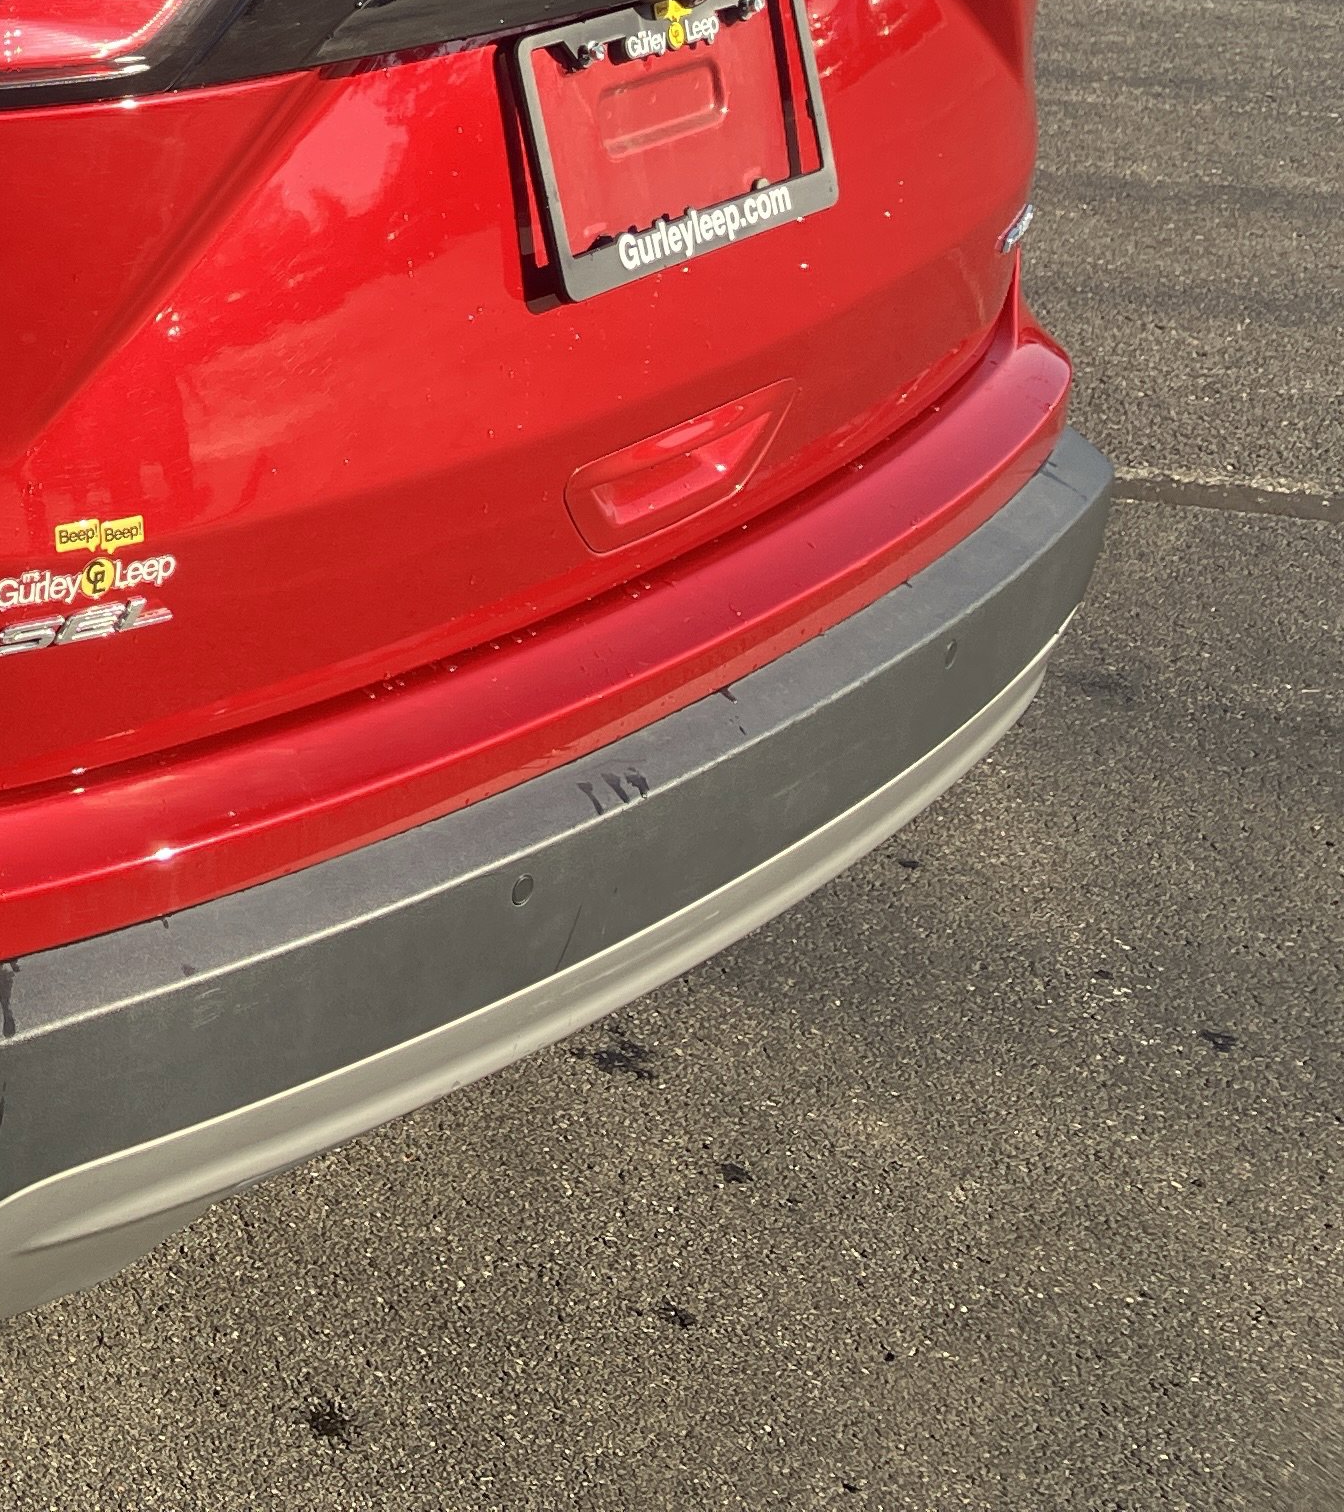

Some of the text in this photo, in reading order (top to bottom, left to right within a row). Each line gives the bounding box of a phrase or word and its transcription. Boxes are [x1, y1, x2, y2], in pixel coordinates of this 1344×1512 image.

[684, 15, 720, 45] Leep
[618, 185, 792, 270] Gurleyleep.com
[58, 521, 143, 545] Beep! Beep!
[115, 554, 176, 588] Leep
